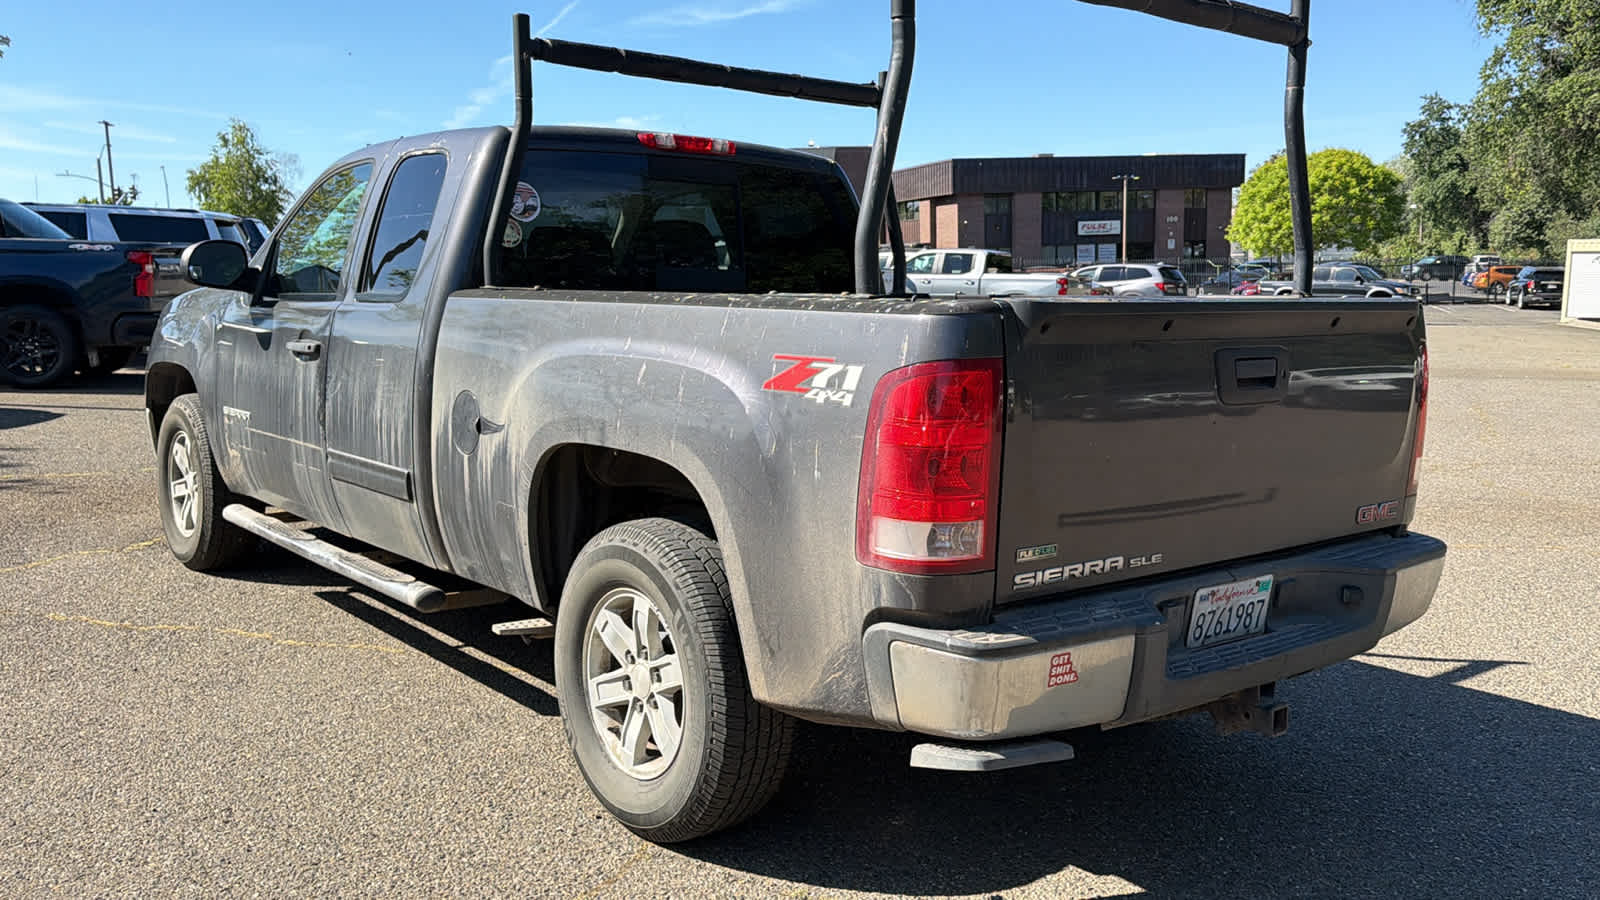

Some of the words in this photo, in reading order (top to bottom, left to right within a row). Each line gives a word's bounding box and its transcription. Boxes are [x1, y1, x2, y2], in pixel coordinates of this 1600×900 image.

[762, 353, 864, 394] Z71
[1357, 501, 1401, 523] GMC
[1013, 556, 1124, 591] SIERRA
[1129, 553, 1163, 568] SLE
[1050, 663, 1072, 676] SHIT
[1052, 655, 1069, 666] GET
